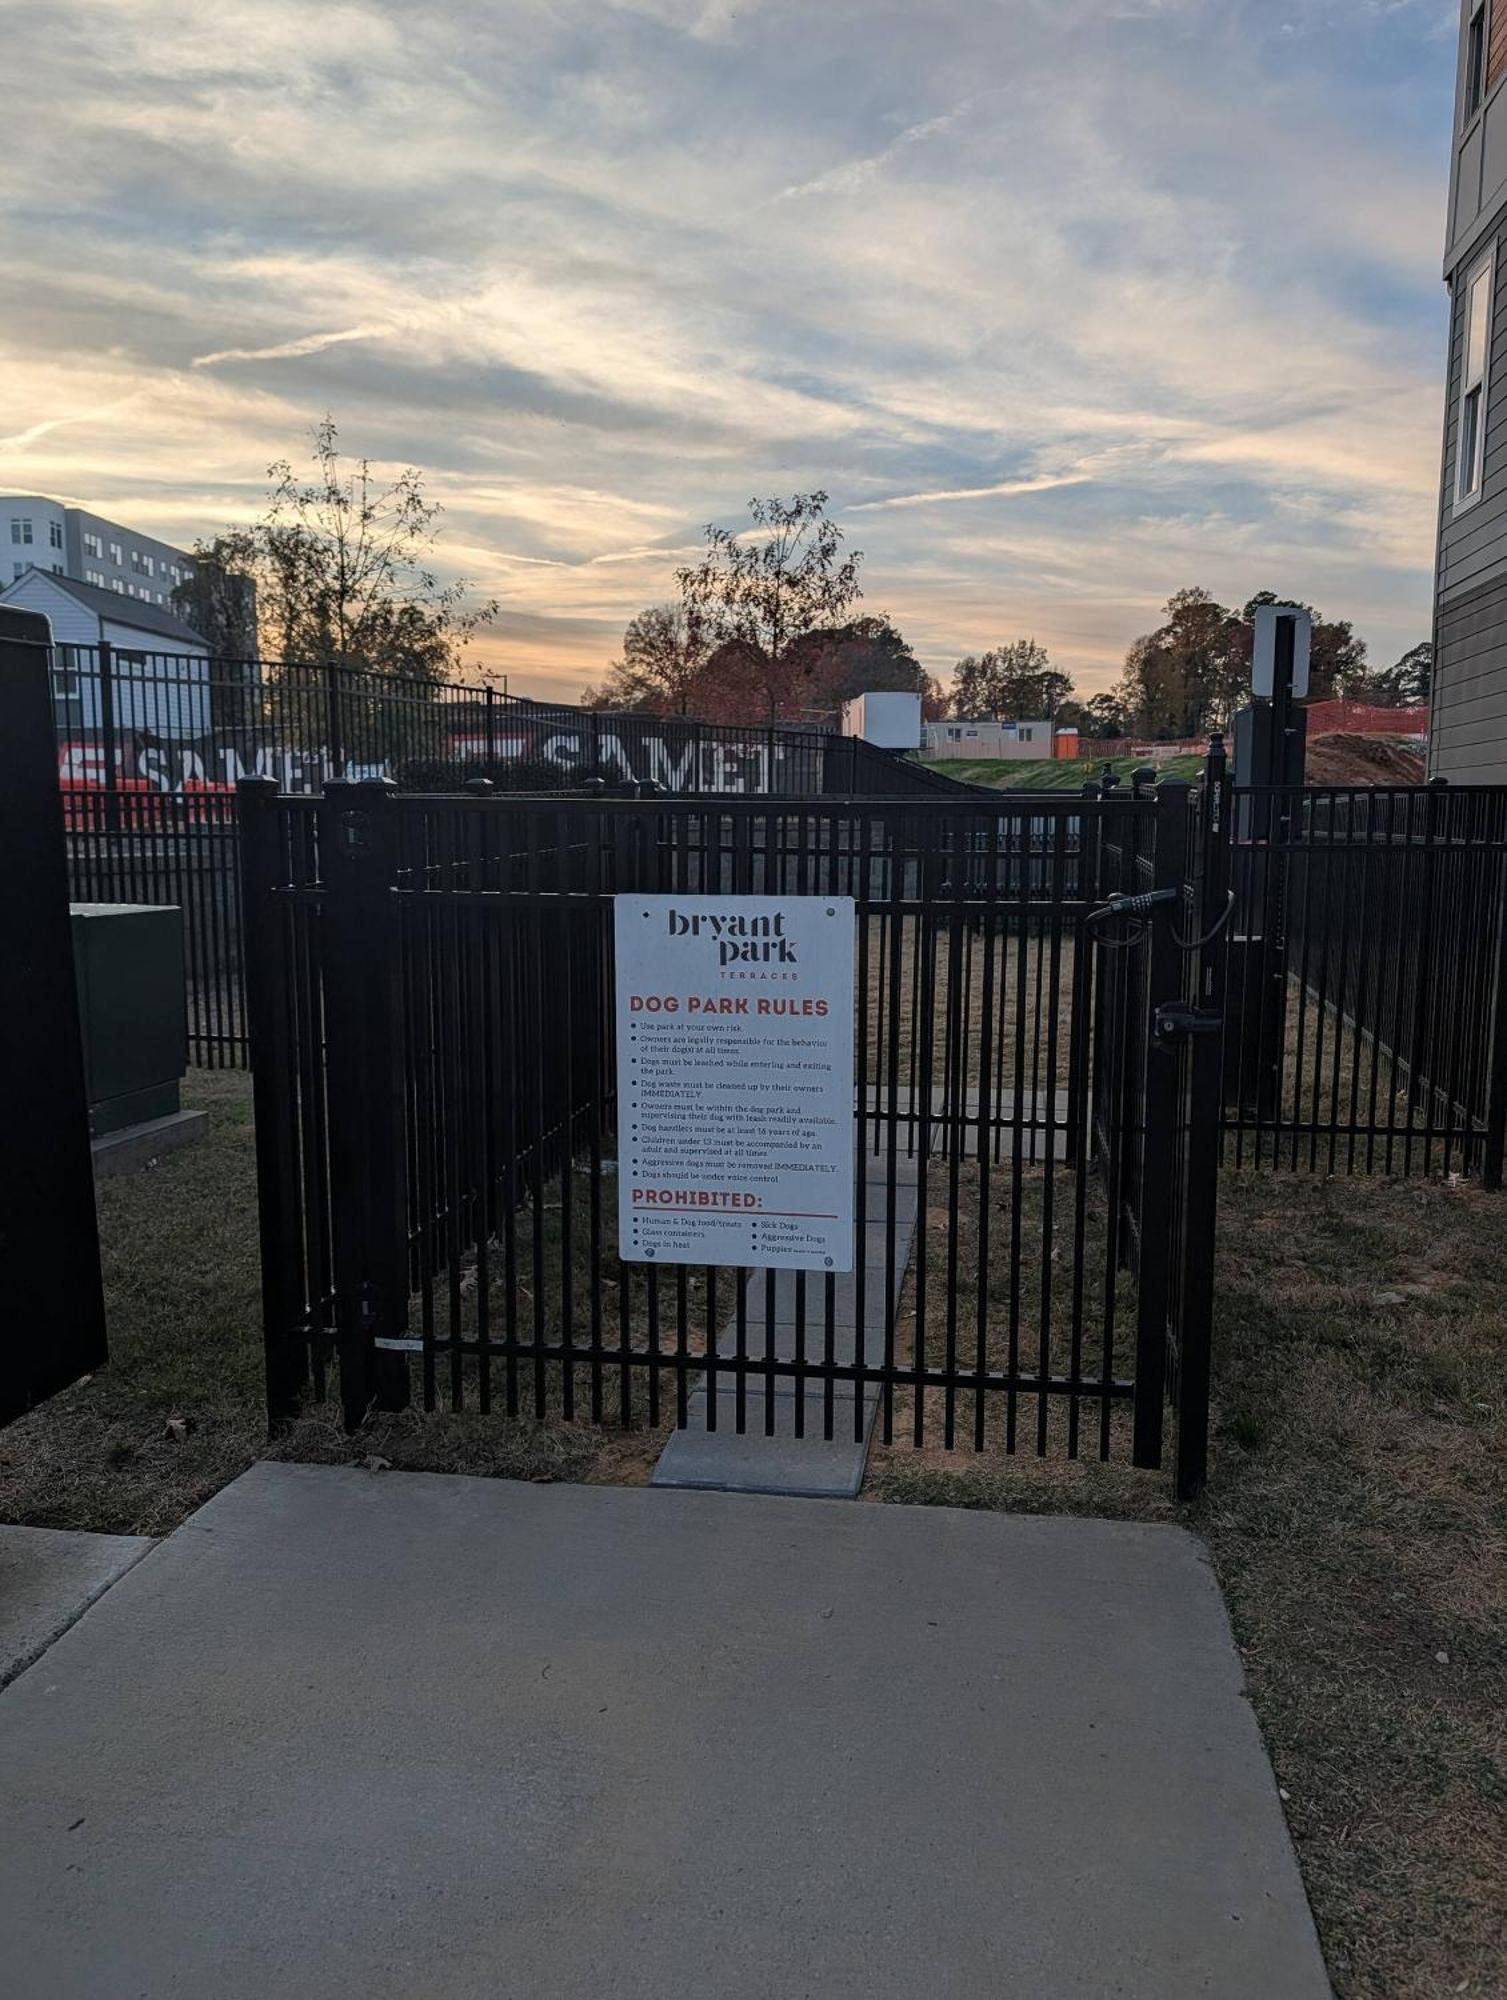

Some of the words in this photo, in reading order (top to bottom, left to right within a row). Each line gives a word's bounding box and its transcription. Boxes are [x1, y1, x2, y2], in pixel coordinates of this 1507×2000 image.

[669, 909, 785, 940] bryant
[720, 938, 798, 966] park
[720, 972, 798, 981] TERRACES
[630, 995, 680, 1012] DOG
[688, 997, 749, 1014] PARK
[758, 999, 829, 1016] RULES
[640, 1022, 654, 1030] Use
[656, 1023, 674, 1031] park
[687, 1036, 713, 1045] legally
[716, 1037, 761, 1046] responsible
[763, 1038, 775, 1046] for
[791, 1038, 827, 1048] behavior
[705, 1046, 716, 1054] all
[640, 1057, 659, 1066] Dogs
[661, 1058, 680, 1066] must
[694, 1059, 723, 1067] leashed
[750, 1062, 784, 1070] entering
[802, 1062, 832, 1071] exiting
[640, 1080, 656, 1088] Dog
[716, 1082, 746, 1090] cleaned
[760, 1083, 770, 1091] by
[771, 1083, 791, 1091] their
[640, 1102, 672, 1110] Owners
[706, 1104, 733, 1112] within
[750, 1106, 764, 1114] dog
[766, 1106, 784, 1114] park
[786, 1106, 801, 1114] and
[640, 1112, 686, 1120] supervising
[688, 1112, 708, 1120] their
[709, 1113, 723, 1121] dog
[768, 1115, 797, 1124] readily
[641, 1123, 656, 1132] Dog
[658, 1124, 693, 1132] handlers
[768, 1129, 790, 1137] years
[791, 1128, 800, 1136] of
[641, 1136, 676, 1144] Children
[735, 1139, 745, 1147] be
[746, 1141, 798, 1149] accompanied
[800, 1142, 810, 1150] by
[734, 1148, 744, 1156] all
[641, 1158, 685, 1167] Aggressive
[685, 1159, 703, 1168] dogs
[641, 1171, 660, 1179] Dogs
[662, 1171, 689, 1179] should
[690, 1172, 700, 1180] be
[632, 1188, 762, 1208] PROHIBITED:
[642, 1217, 671, 1225] Human
[681, 1219, 697, 1227] Dog
[698, 1219, 742, 1228] food/treats
[761, 1221, 777, 1229] Sick
[779, 1222, 798, 1231] Dogs
[642, 1228, 662, 1236] Glass
[664, 1230, 705, 1238] containers
[761, 1233, 805, 1241] Aggressive
[806, 1234, 825, 1244] Dogs
[642, 1240, 661, 1248] Dogs
[672, 1241, 690, 1249] heat
[761, 1244, 792, 1253] Puppies
